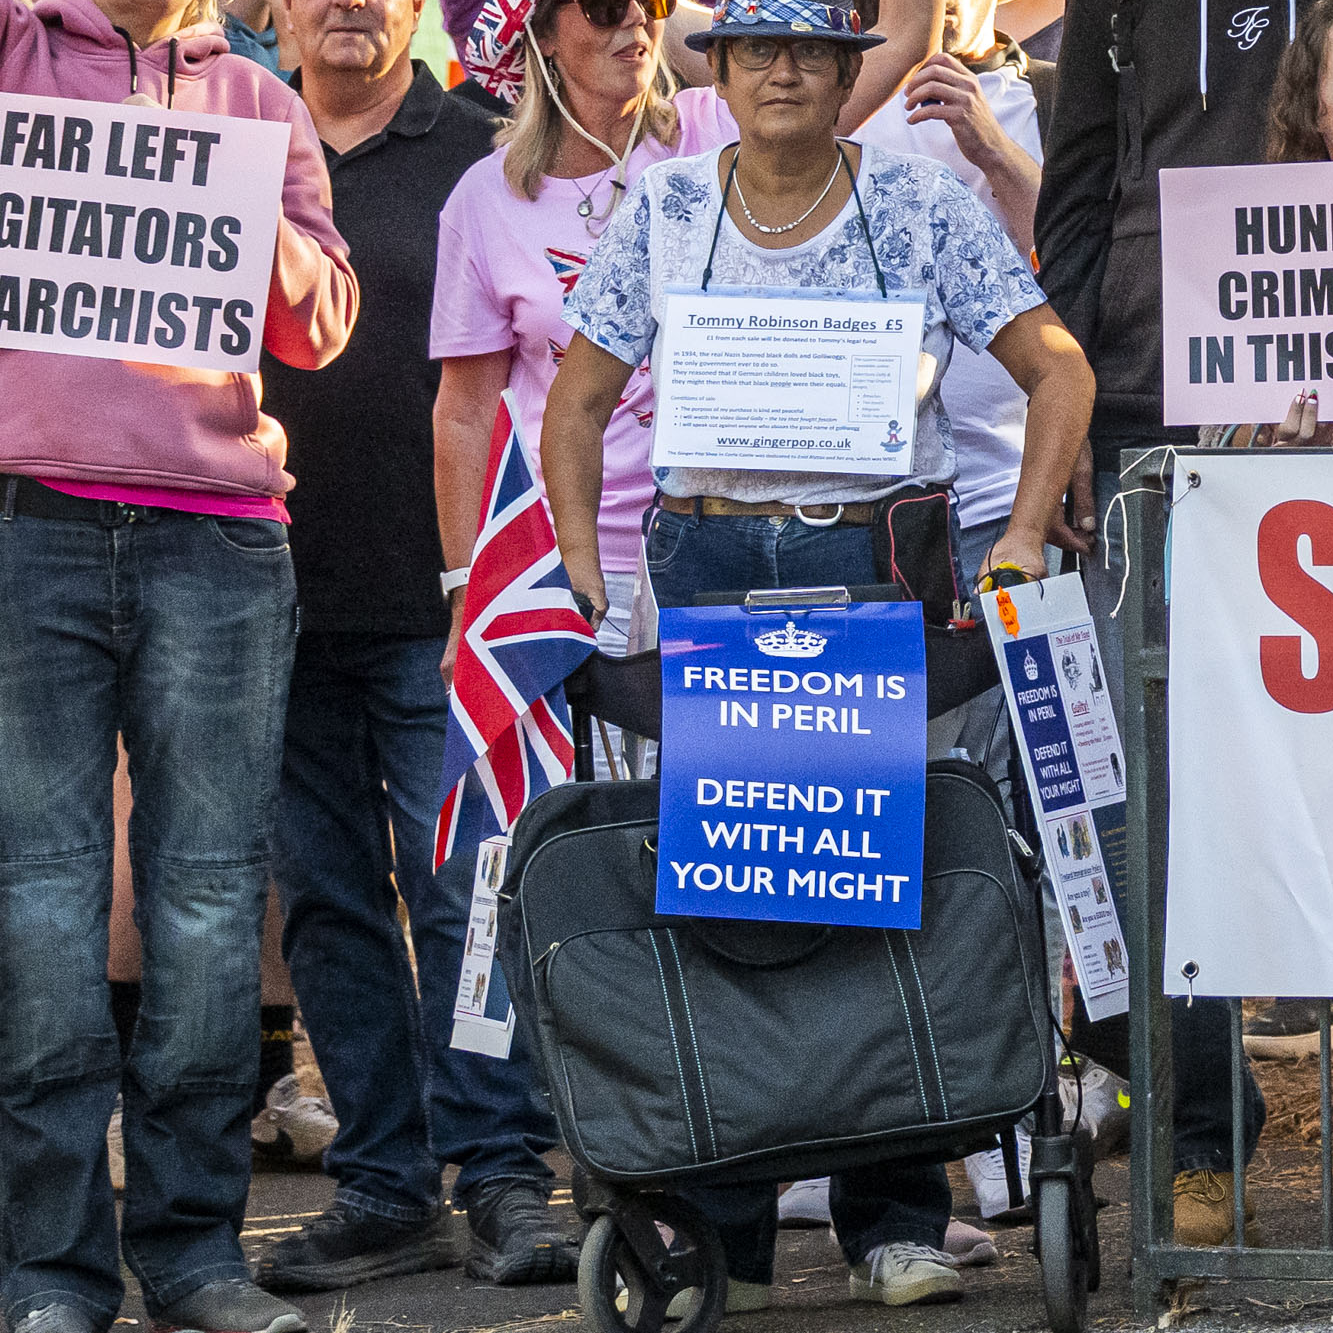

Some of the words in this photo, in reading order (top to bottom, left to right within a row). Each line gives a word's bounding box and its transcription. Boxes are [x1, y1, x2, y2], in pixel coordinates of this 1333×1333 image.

[0, 110, 93, 173] FAR
[104, 120, 221, 187] LEFT
[688, 314, 745, 329] Tommy
[749, 315, 818, 329] Robinson
[823, 317, 877, 332] Badges
[885, 319, 903, 330] £5
[1188, 335, 1235, 385] IN
[717, 436, 852, 449] www.gingerpop.co.uk
[683, 666, 864, 698] FREEDOM
[876, 674, 907, 700] IS
[1017, 687, 1052, 706] FREEDOM
[1052, 685, 1058, 698] IS
[719, 700, 759, 728] IN
[772, 702, 872, 735] PERIL
[1028, 709, 1037, 723] IN
[1037, 705, 1057, 721] PERIL
[1034, 743, 1061, 761] DEFEND
[1061, 741, 1068, 755] IT
[1040, 764, 1059, 780] WITH
[1060, 761, 1073, 776] ALL
[696, 778, 845, 813] DEFEND
[855, 788, 891, 817] IT
[1040, 784, 1060, 800] YOUR
[1060, 779, 1081, 796] MIGHT
[700, 820, 804, 854] WITH
[812, 827, 882, 859] ALL
[669, 860, 776, 896] YOUR
[786, 867, 910, 903] MIGHT
